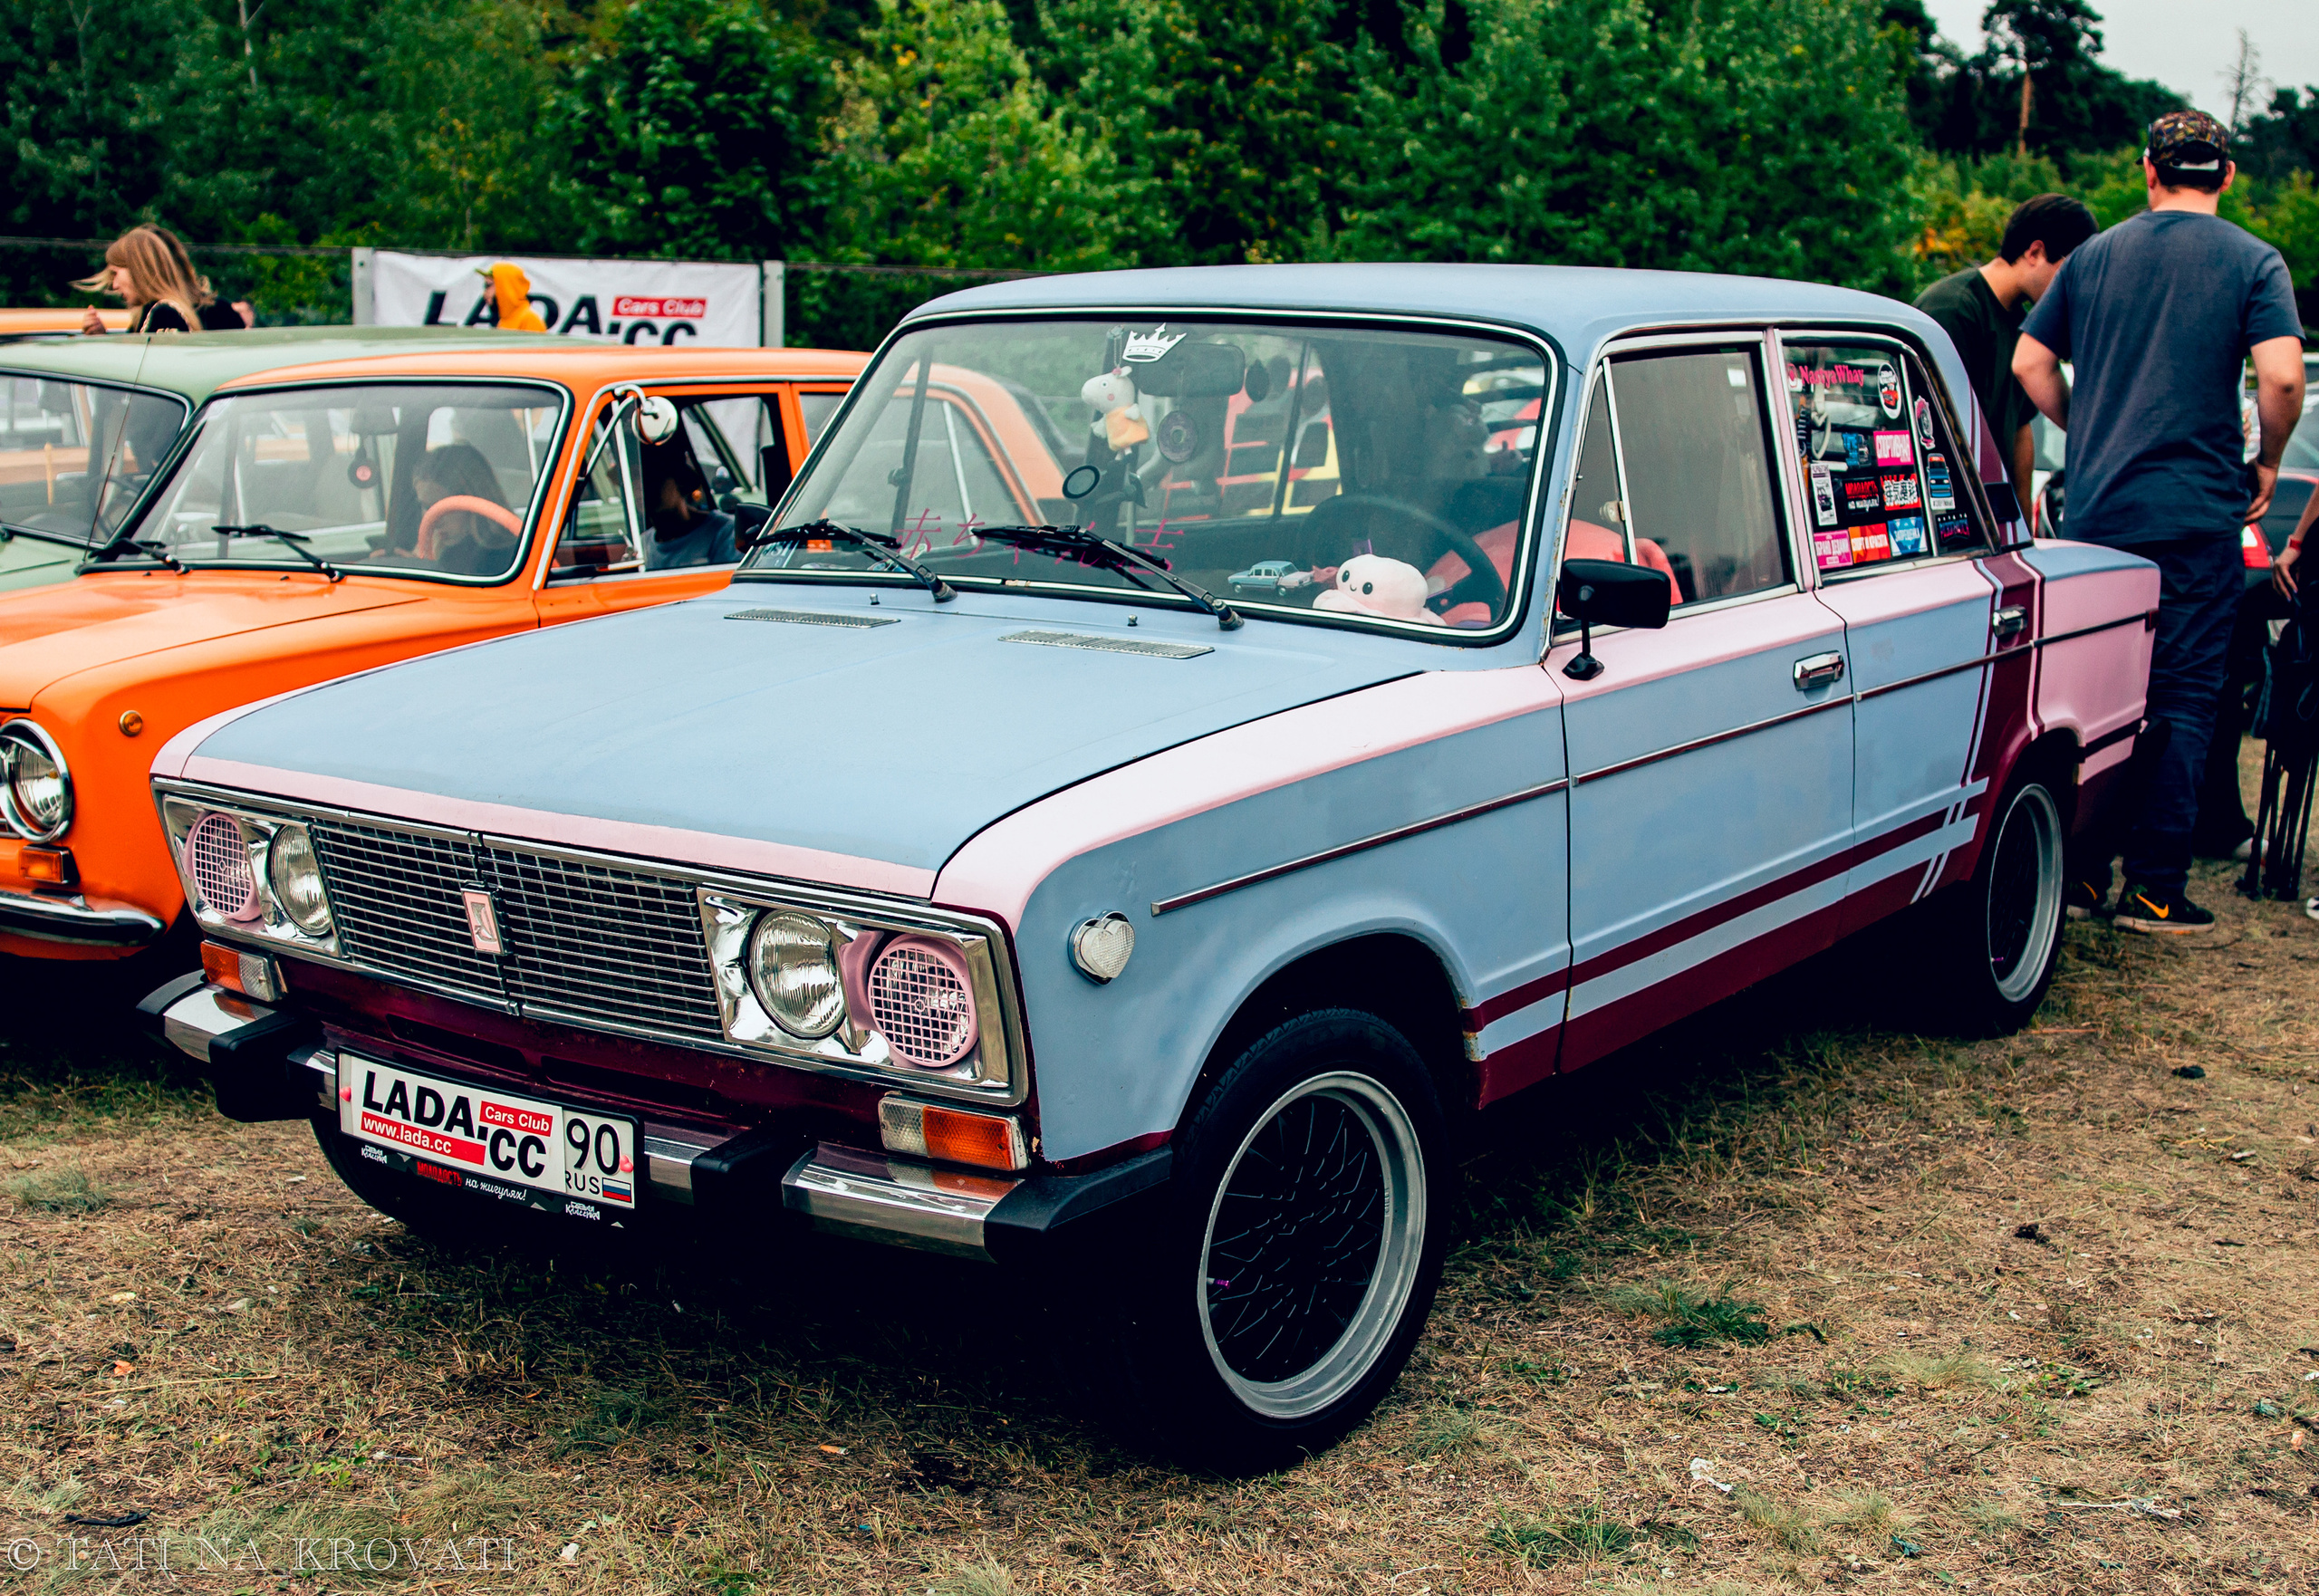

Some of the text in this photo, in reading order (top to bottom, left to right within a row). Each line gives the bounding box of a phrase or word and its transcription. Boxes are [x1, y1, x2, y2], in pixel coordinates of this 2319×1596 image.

[618, 299, 704, 314] Cars Club
[485, 1106, 551, 1132] Cars Club
[363, 1116, 452, 1154] www.lada.cc
[565, 1118, 621, 1176] 90
[465, 1178, 479, 1188] на
[565, 1170, 600, 1195] RUS
